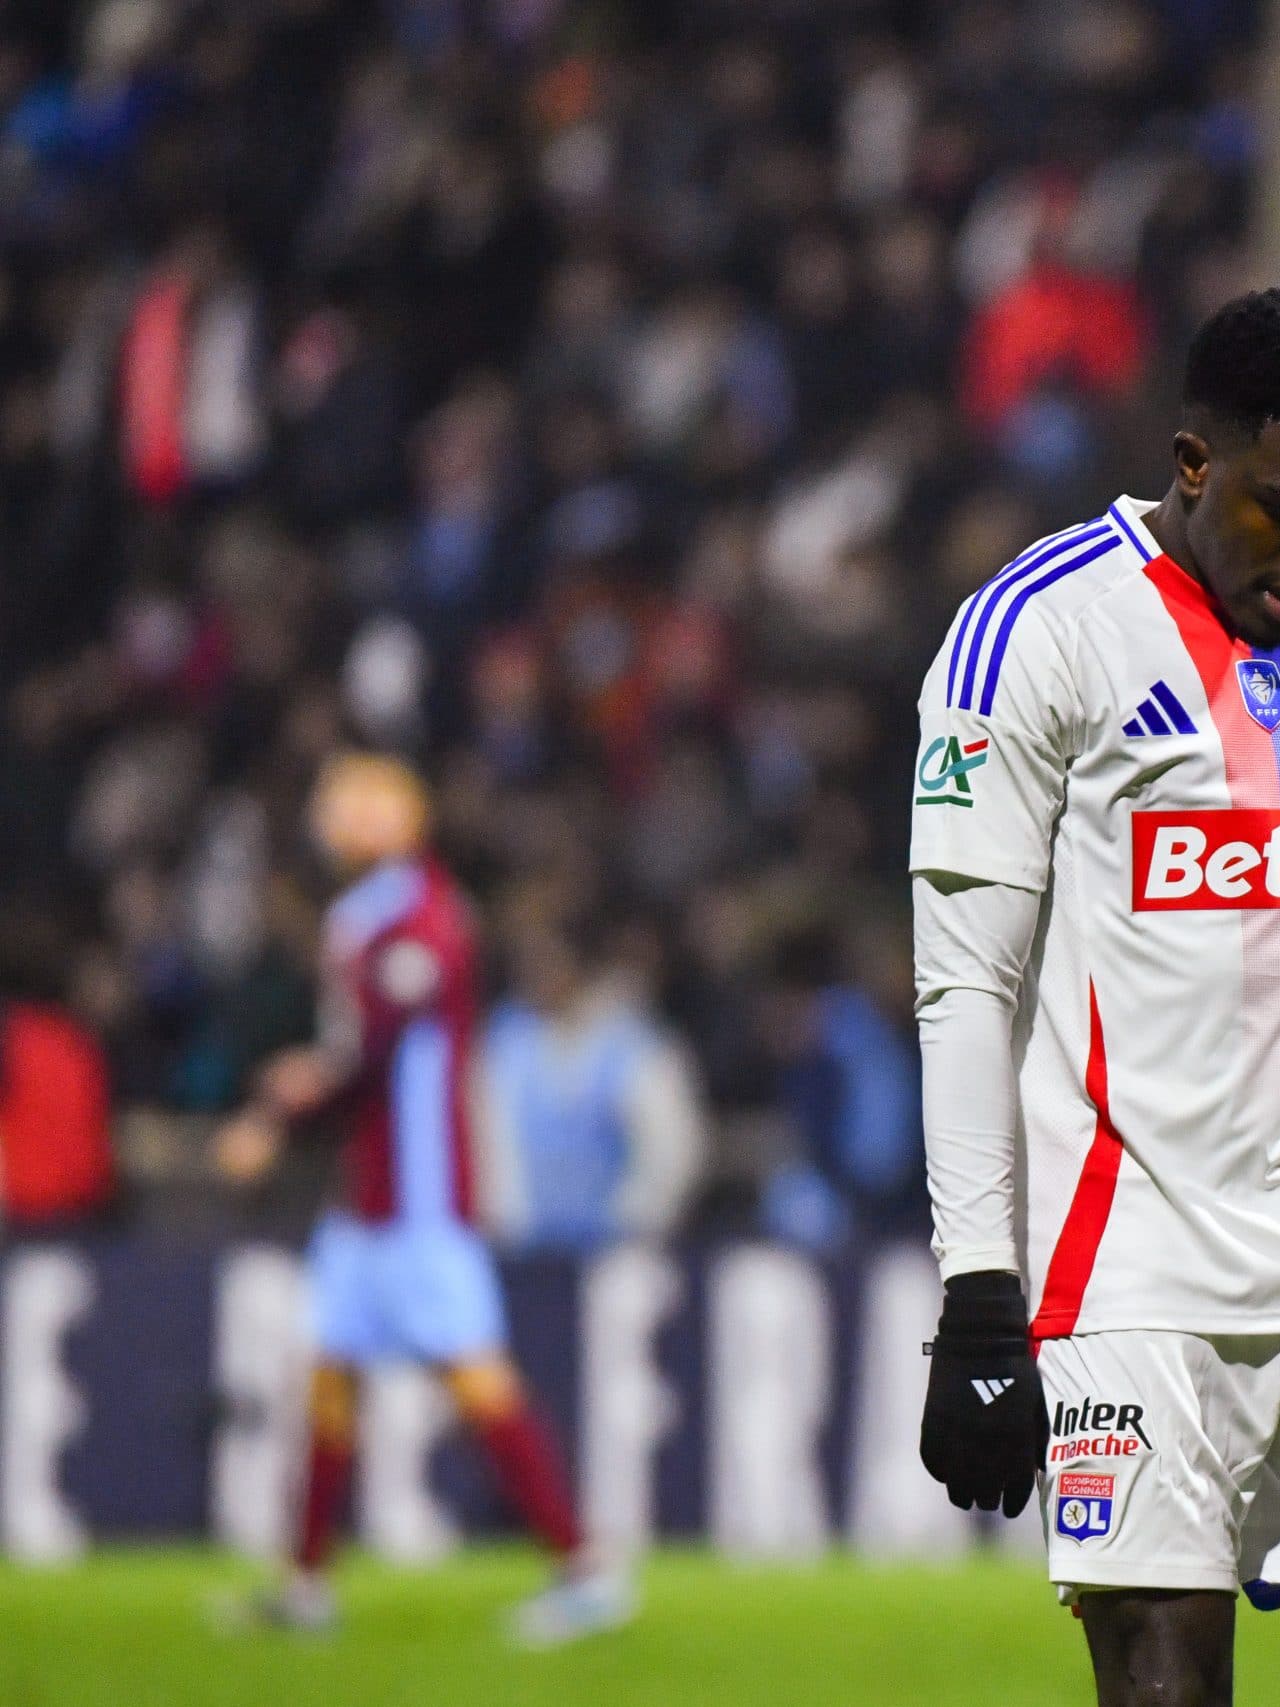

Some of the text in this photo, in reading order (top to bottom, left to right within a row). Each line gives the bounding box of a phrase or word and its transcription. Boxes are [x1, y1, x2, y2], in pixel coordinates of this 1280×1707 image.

[1256, 708, 1279, 717] FFF
[1063, 1476, 1111, 1487] OLYMPIQUE
[1063, 1486, 1110, 1496] LYONNAIS
[1062, 1499, 1106, 1530] OL
